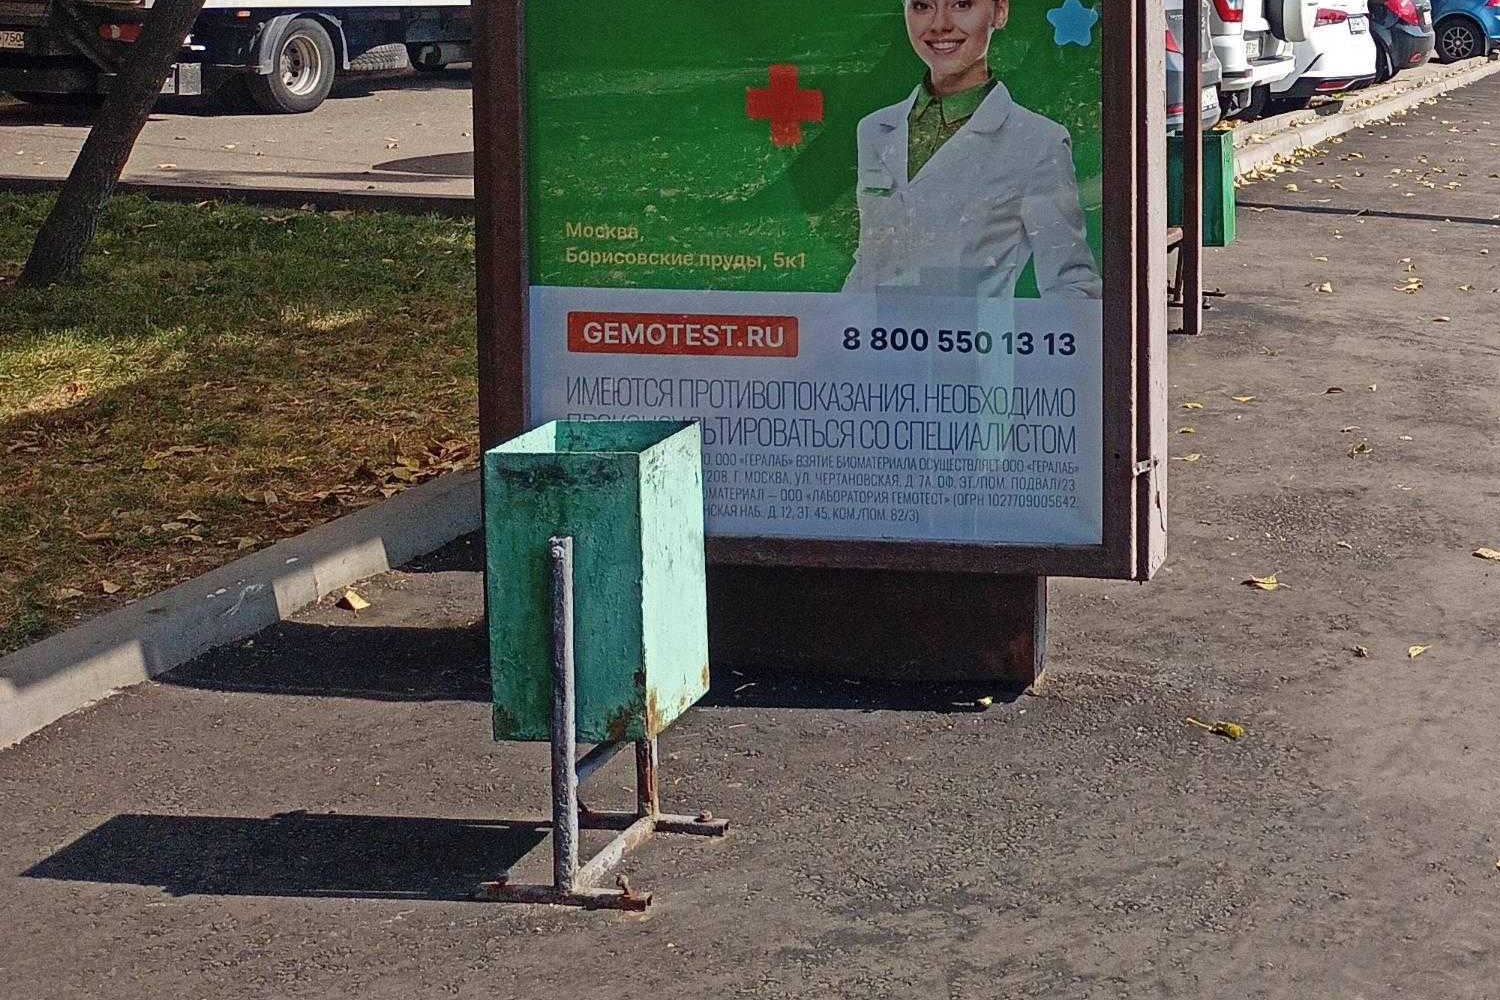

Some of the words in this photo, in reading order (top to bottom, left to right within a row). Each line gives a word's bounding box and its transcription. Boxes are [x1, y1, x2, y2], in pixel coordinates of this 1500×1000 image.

[565, 222, 645, 242] Москва,
[565, 246, 694, 266] Борисовские
[699, 252, 768, 272] пруды,
[772, 251, 806, 269] 5к1
[583, 321, 785, 348] GEMOTEST.RU
[843, 327, 861, 351] 8
[870, 327, 929, 352] 800
[937, 329, 993, 354] 550
[1001, 331, 1034, 355] 13
[1043, 332, 1077, 356] 13
[566, 376, 673, 408] ИМЕЮТСЯ
[679, 379, 920, 414] ПРОТИВОПОКАЗАНИЯ.
[925, 384, 1077, 420] НЕОБХОДИМО
[859, 419, 890, 450] СО
[894, 420, 1077, 456] СПЕЦИАЛИСТОМ
[716, 453, 736, 466] ООО
[796, 455, 834, 469] ВЗЯТИЕ
[836, 456, 917, 471] БИОМАТЕРИАЛА
[919, 458, 999, 475] ОСУЩЕСТВЛЯЕТ
[1002, 459, 1024, 474] ООО
[781, 488, 803, 502] ООО
